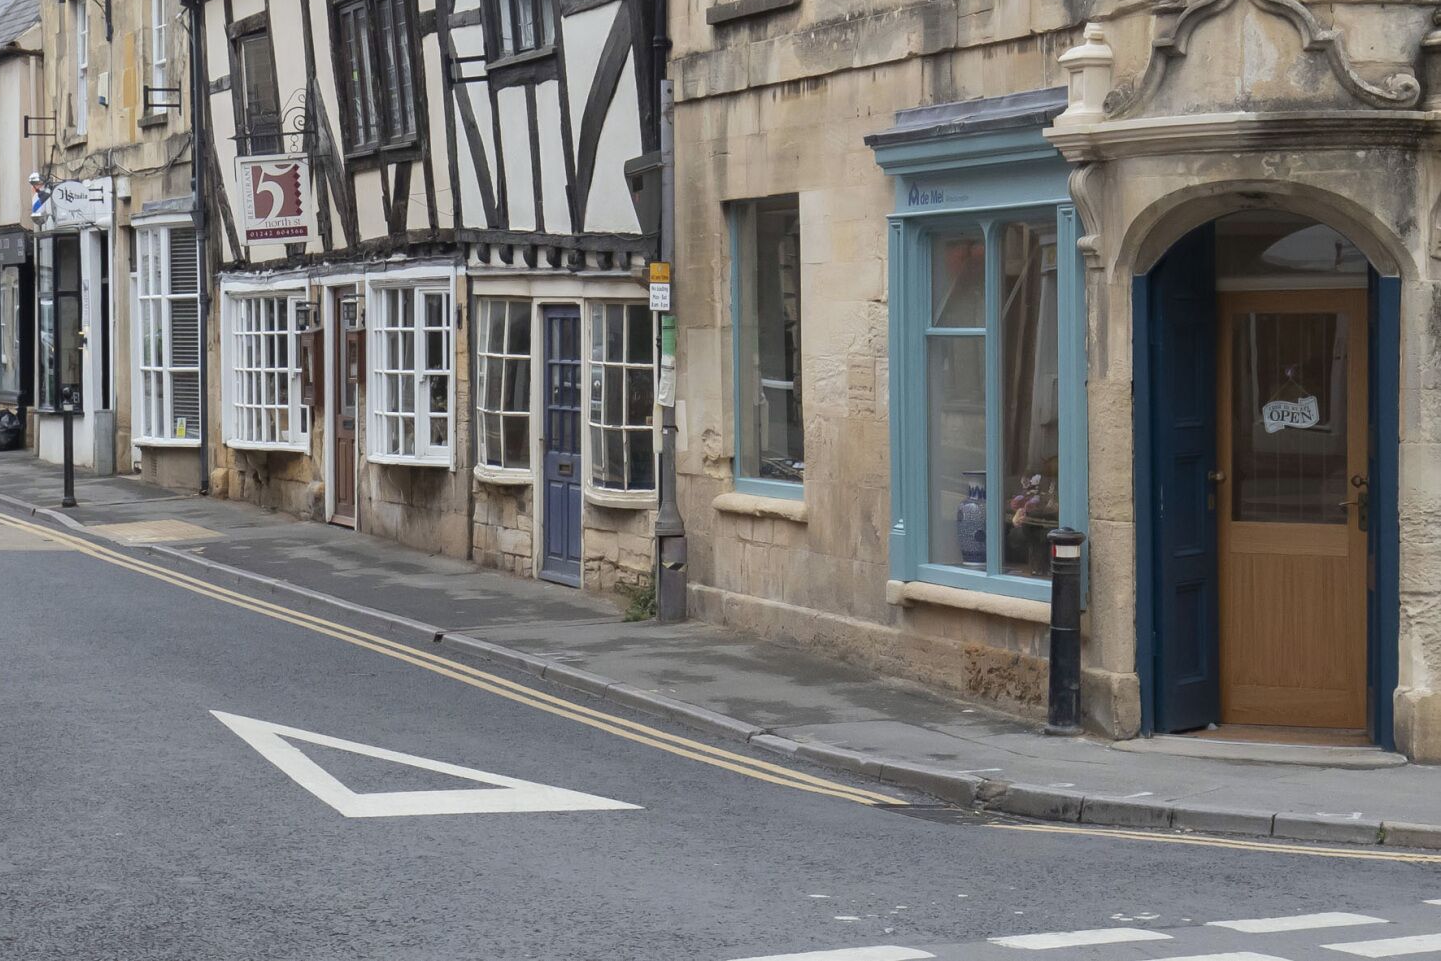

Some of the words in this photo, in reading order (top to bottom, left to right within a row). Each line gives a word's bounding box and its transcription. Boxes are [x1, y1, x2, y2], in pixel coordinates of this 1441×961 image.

[244, 166, 254, 220] RESTAURANT
[252, 162, 298, 226] 5
[920, 191, 930, 205] de
[264, 218, 291, 228] north
[293, 218, 301, 227] st
[249, 230, 273, 238] 01242
[1269, 409, 1313, 424] OPEN
